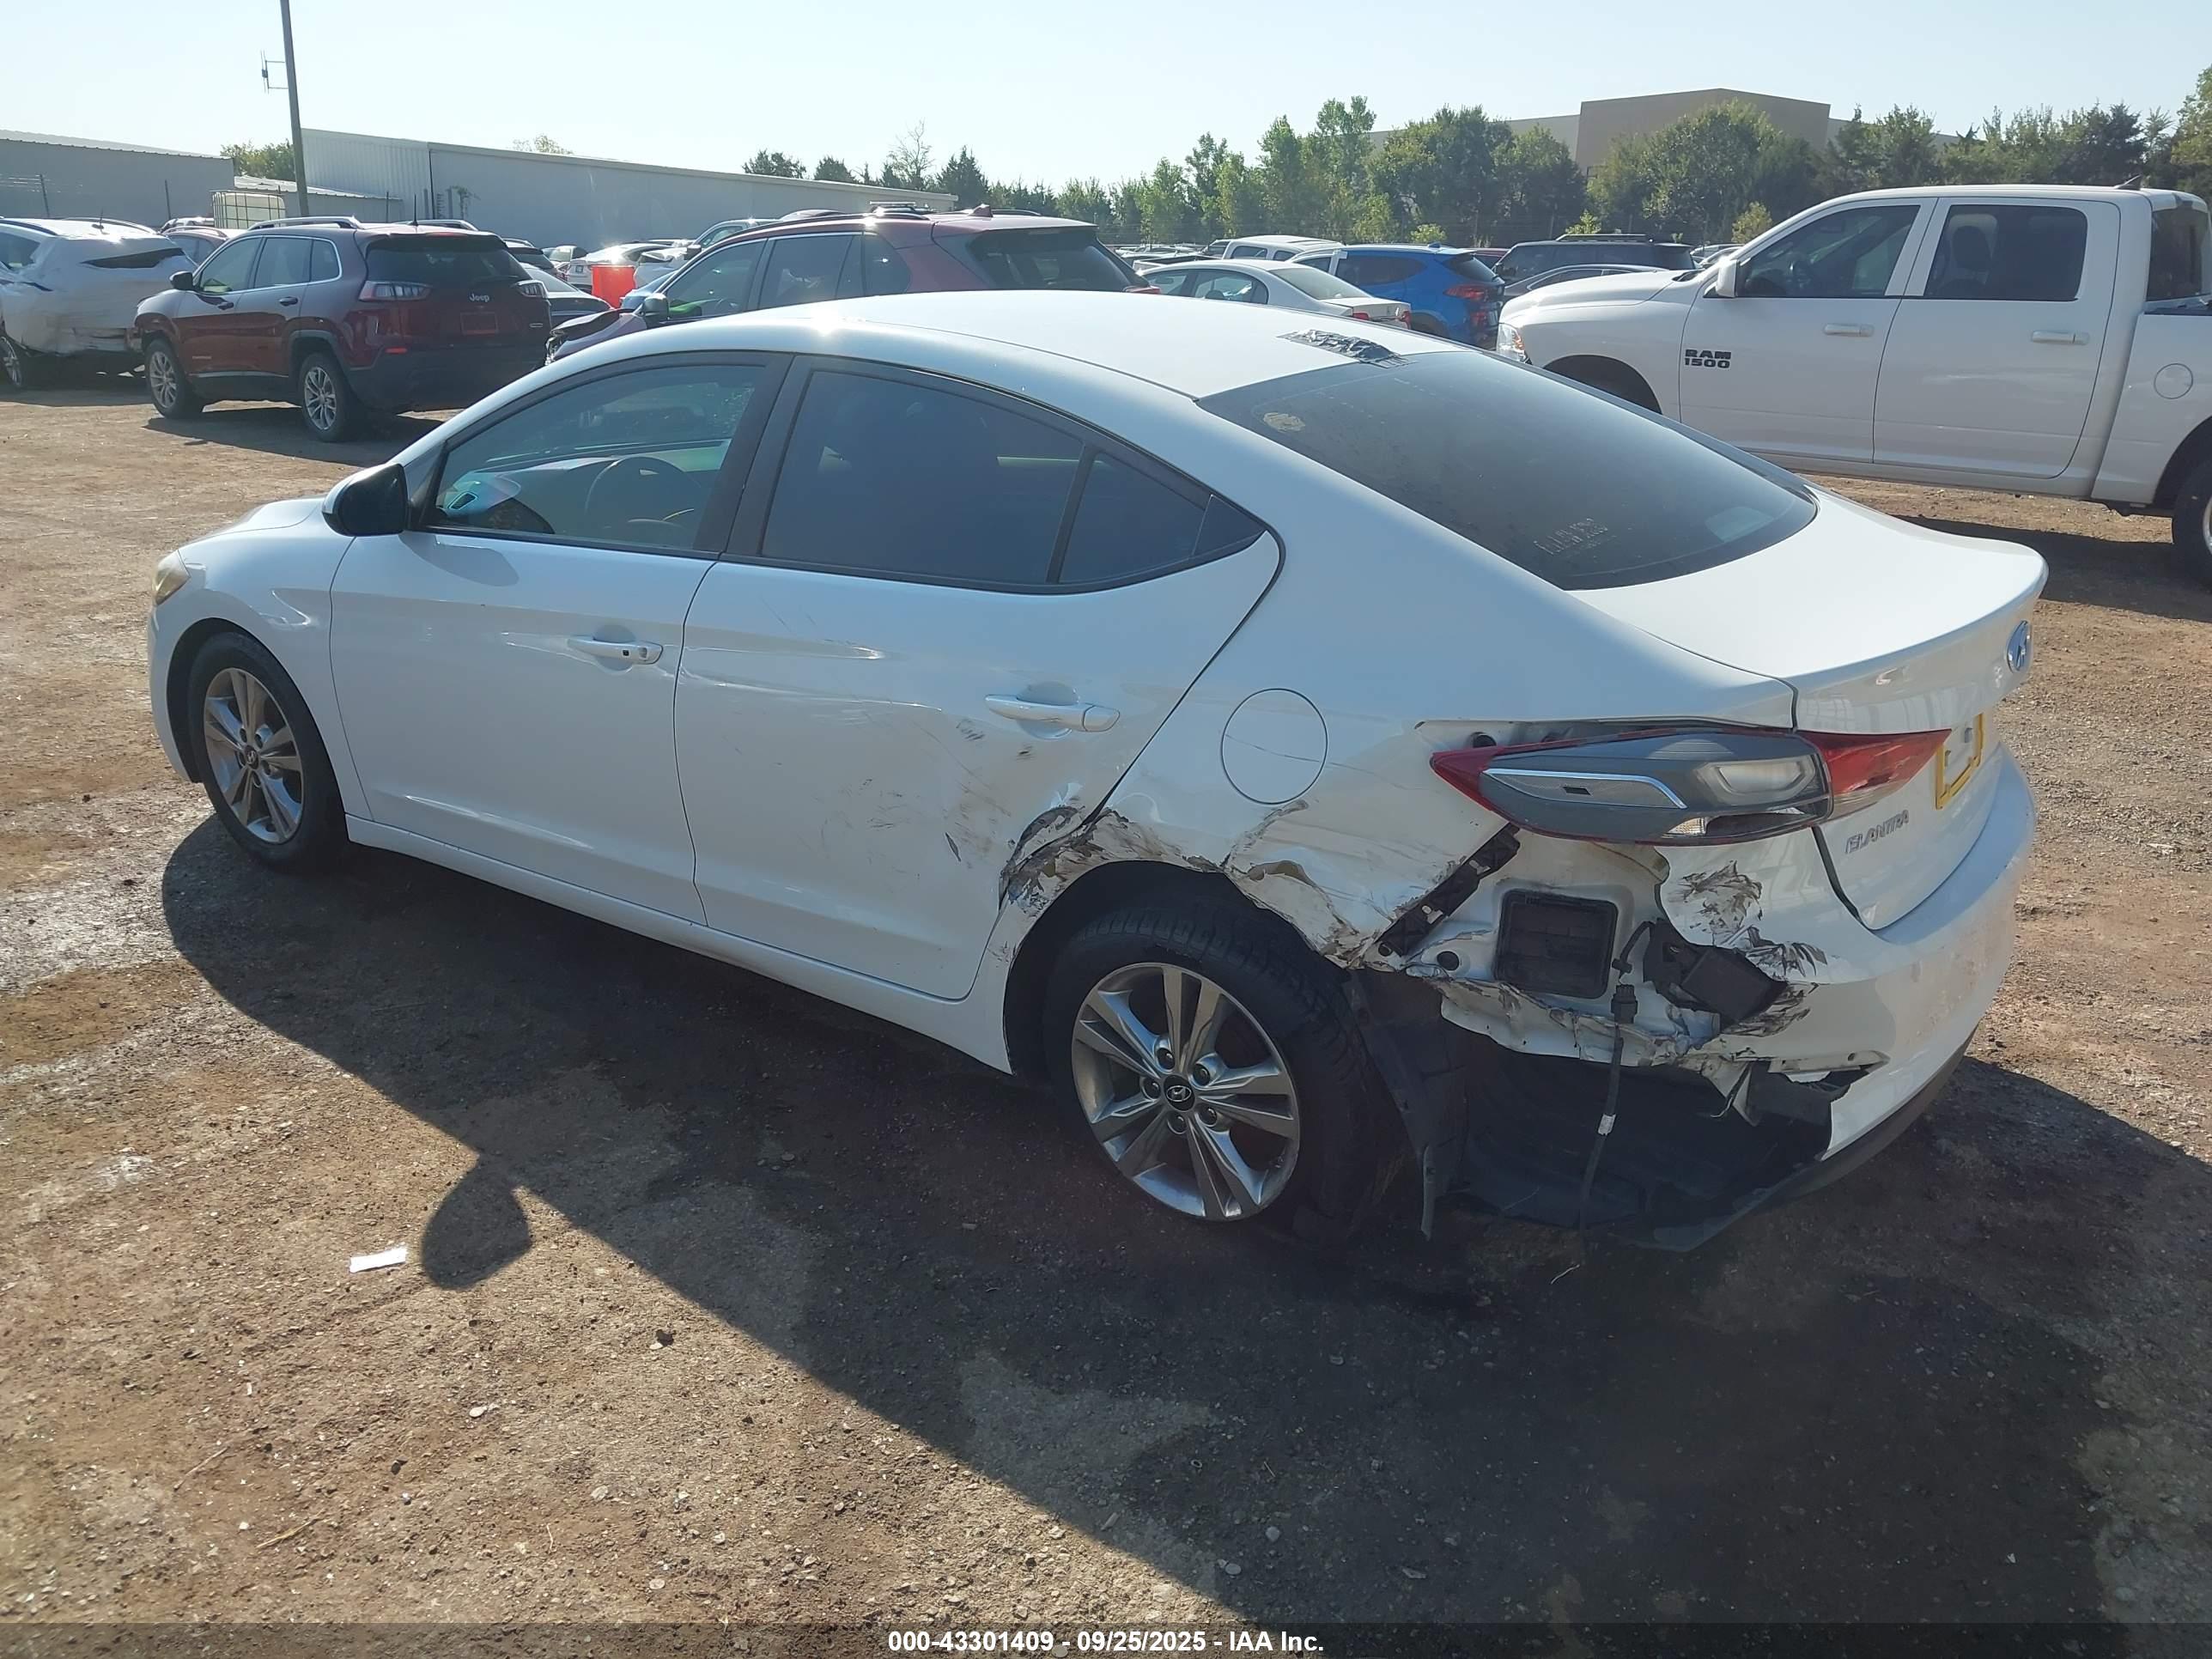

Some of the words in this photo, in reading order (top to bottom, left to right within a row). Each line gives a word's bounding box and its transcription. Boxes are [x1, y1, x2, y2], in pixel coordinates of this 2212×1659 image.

[469, 293, 490, 303] Jeep
[1685, 349, 1732, 360] RAM
[1684, 357, 1731, 369] 1500
